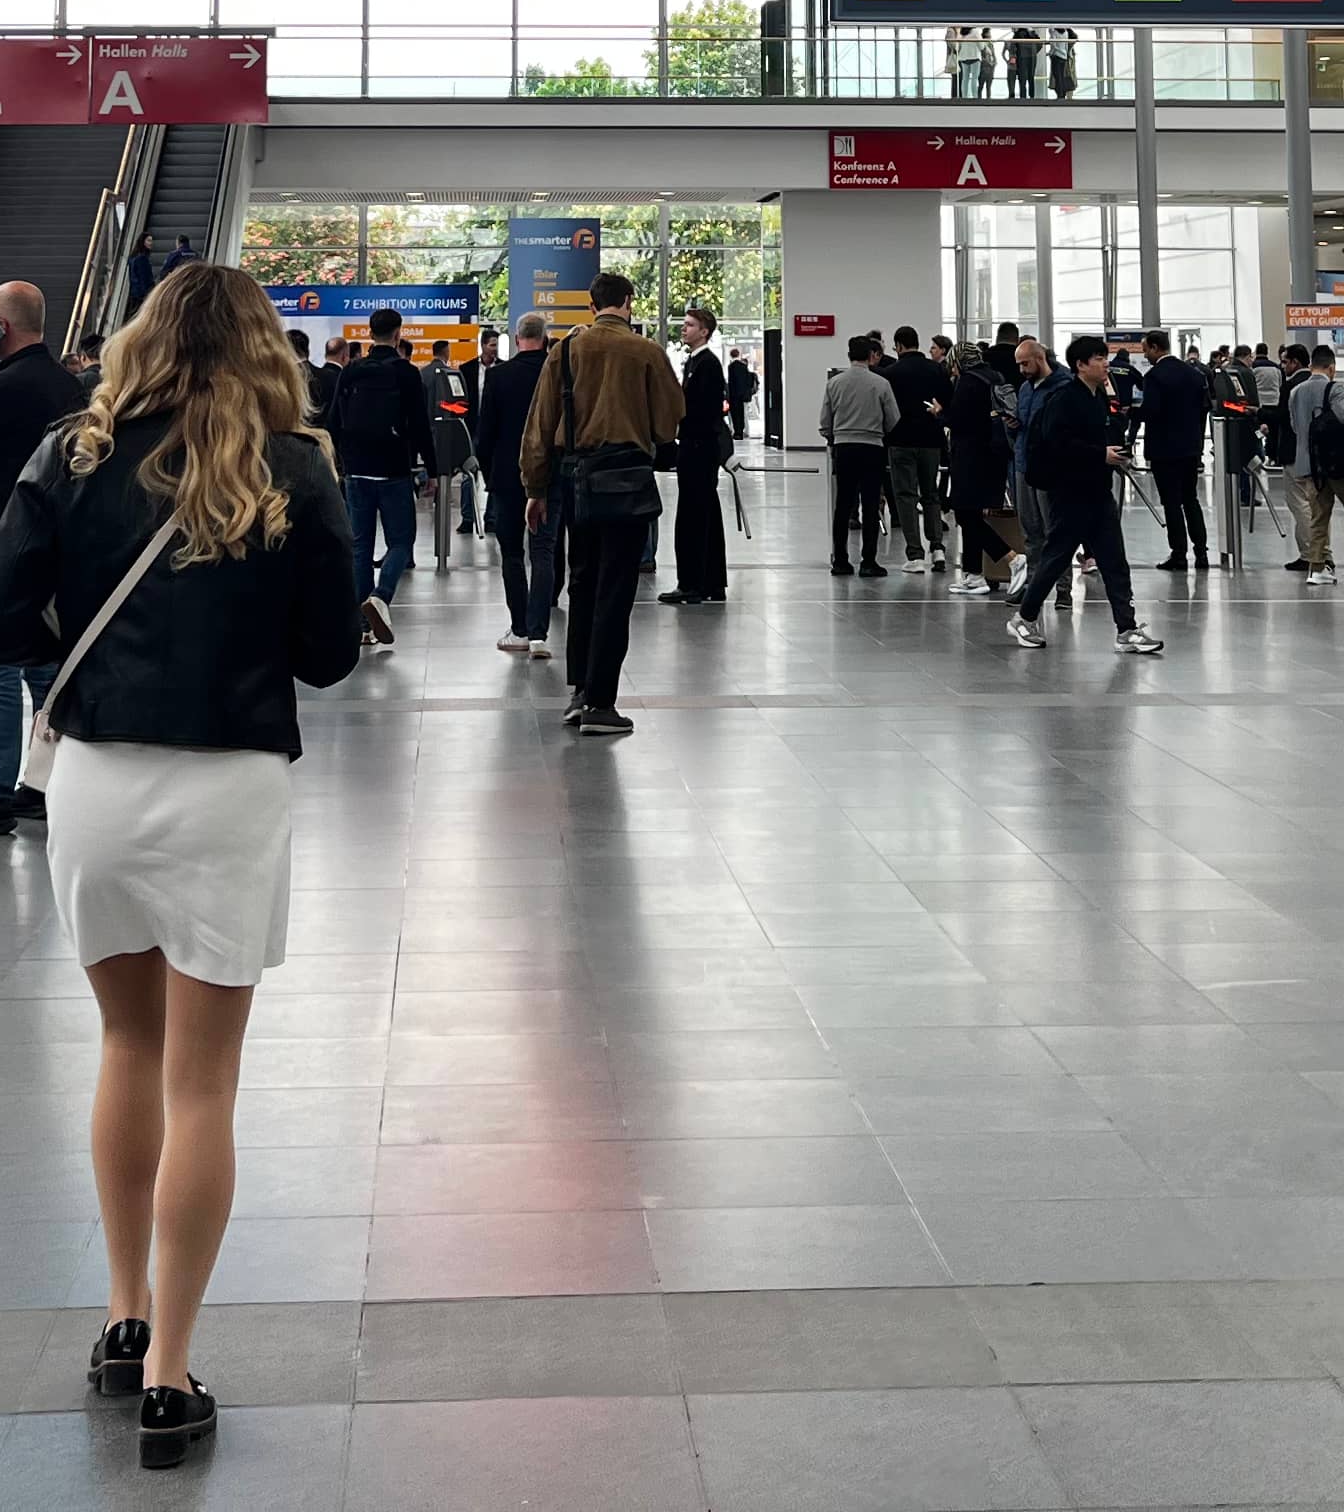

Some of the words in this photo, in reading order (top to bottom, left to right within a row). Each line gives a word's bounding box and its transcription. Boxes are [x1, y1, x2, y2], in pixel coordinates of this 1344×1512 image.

[99, 46, 146, 58] Hallen
[152, 45, 187, 58] Halls
[98, 70, 144, 115] A
[955, 136, 988, 145] Hallen
[991, 136, 1016, 146] Halls
[833, 161, 884, 170] Konferenz
[887, 161, 896, 170] A
[957, 154, 988, 185] A
[833, 175, 888, 184] Conference
[891, 175, 899, 184] A
[538, 292, 555, 303] A6
[344, 299, 350, 309] 7
[353, 299, 417, 309] EXHIBITION
[420, 298, 468, 308] FORUMS
[1289, 308, 1305, 316] GET
[1307, 308, 1330, 316] YOUR
[1319, 317, 1344, 325] GUIDE
